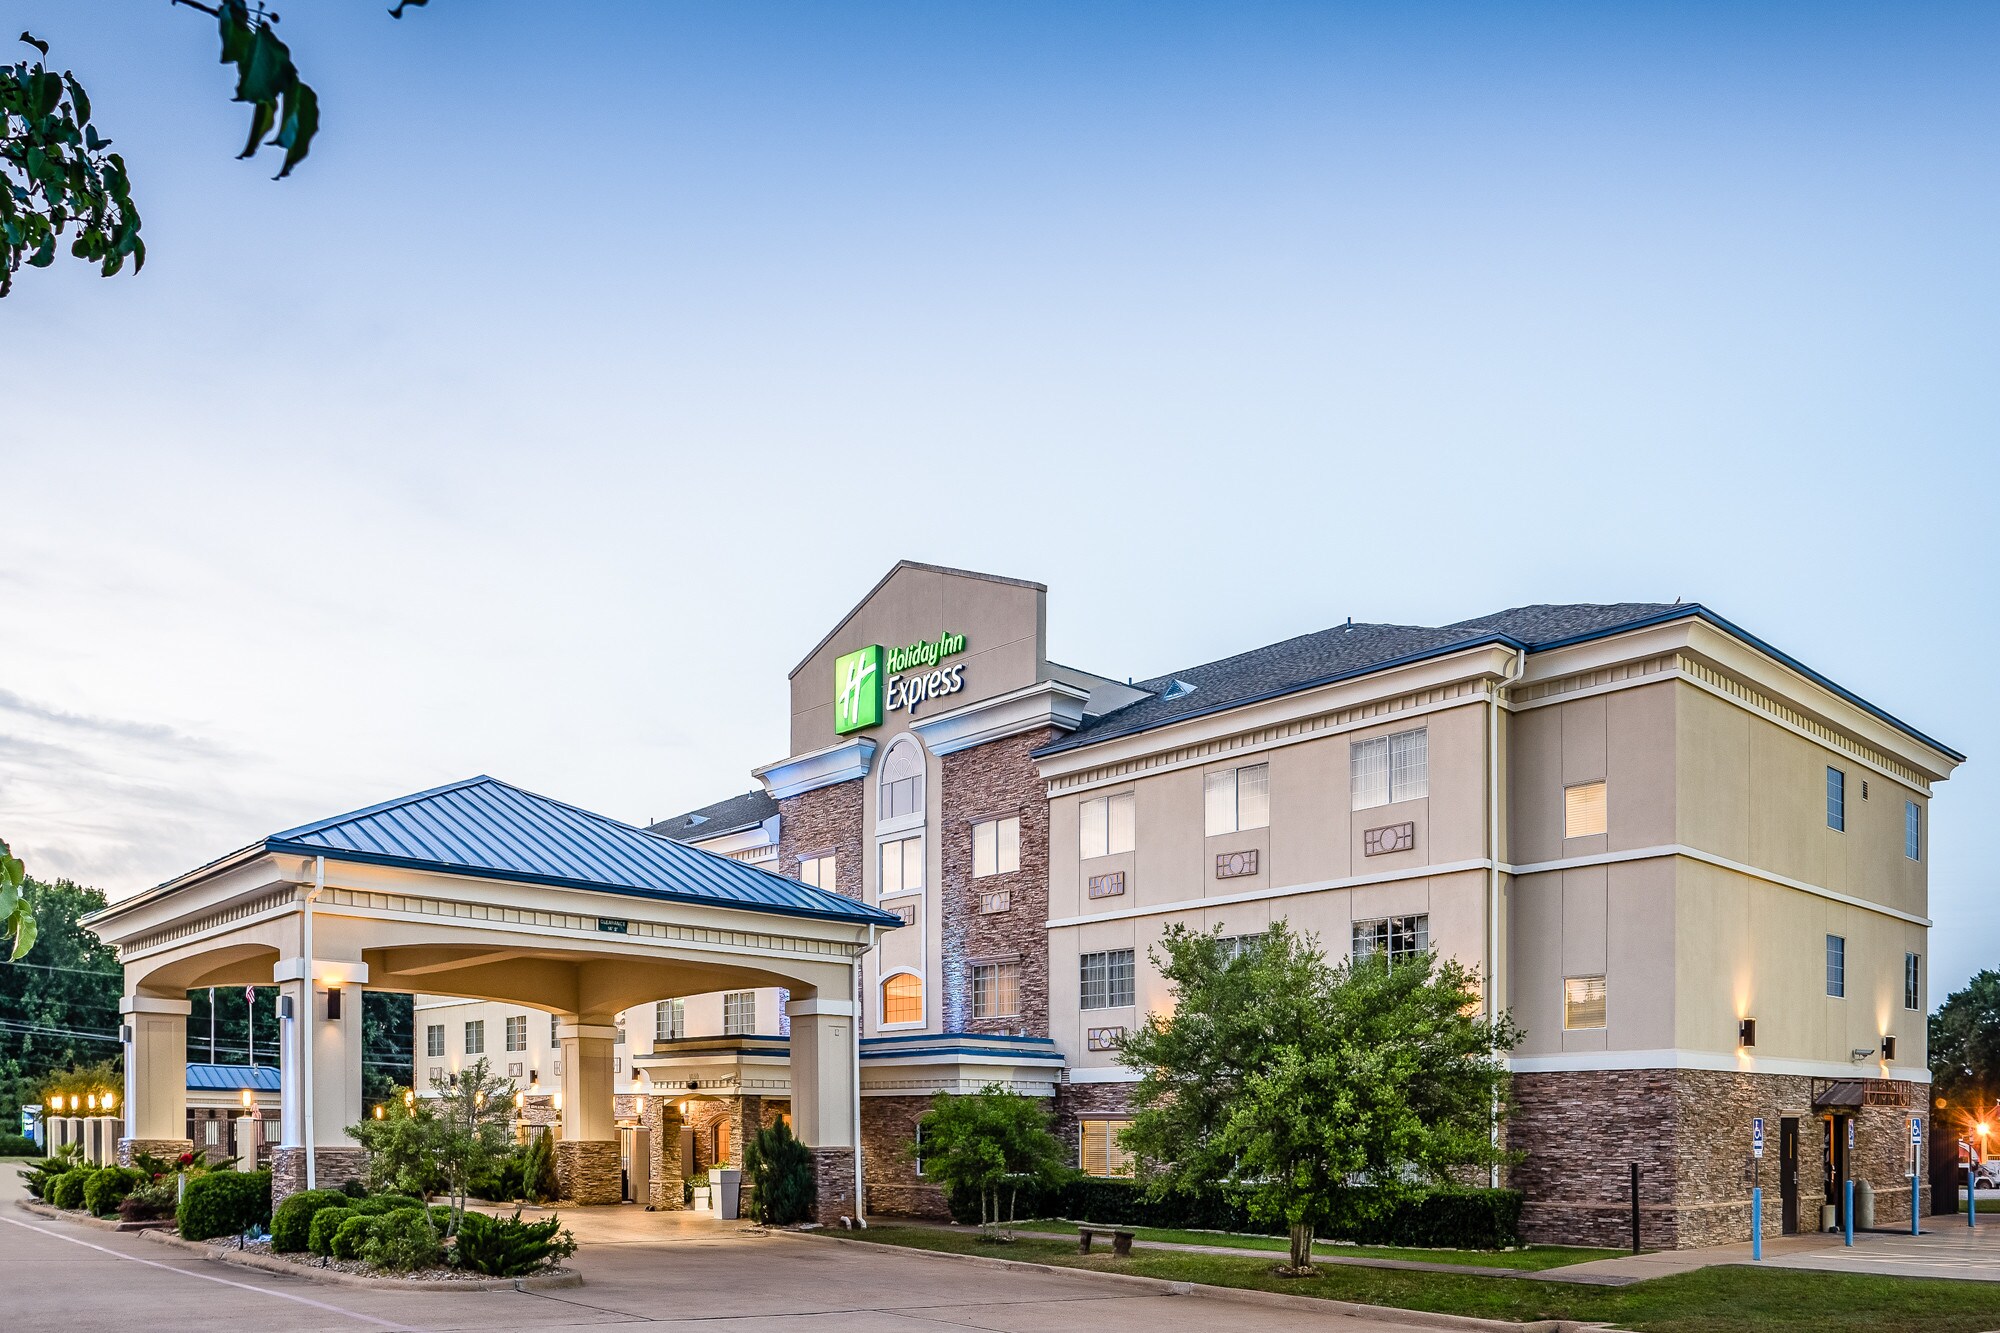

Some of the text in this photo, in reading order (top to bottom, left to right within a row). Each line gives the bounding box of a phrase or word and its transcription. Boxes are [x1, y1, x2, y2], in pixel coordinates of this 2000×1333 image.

[886, 631, 965, 675] Holiday Inn
[886, 663, 964, 714] Express
